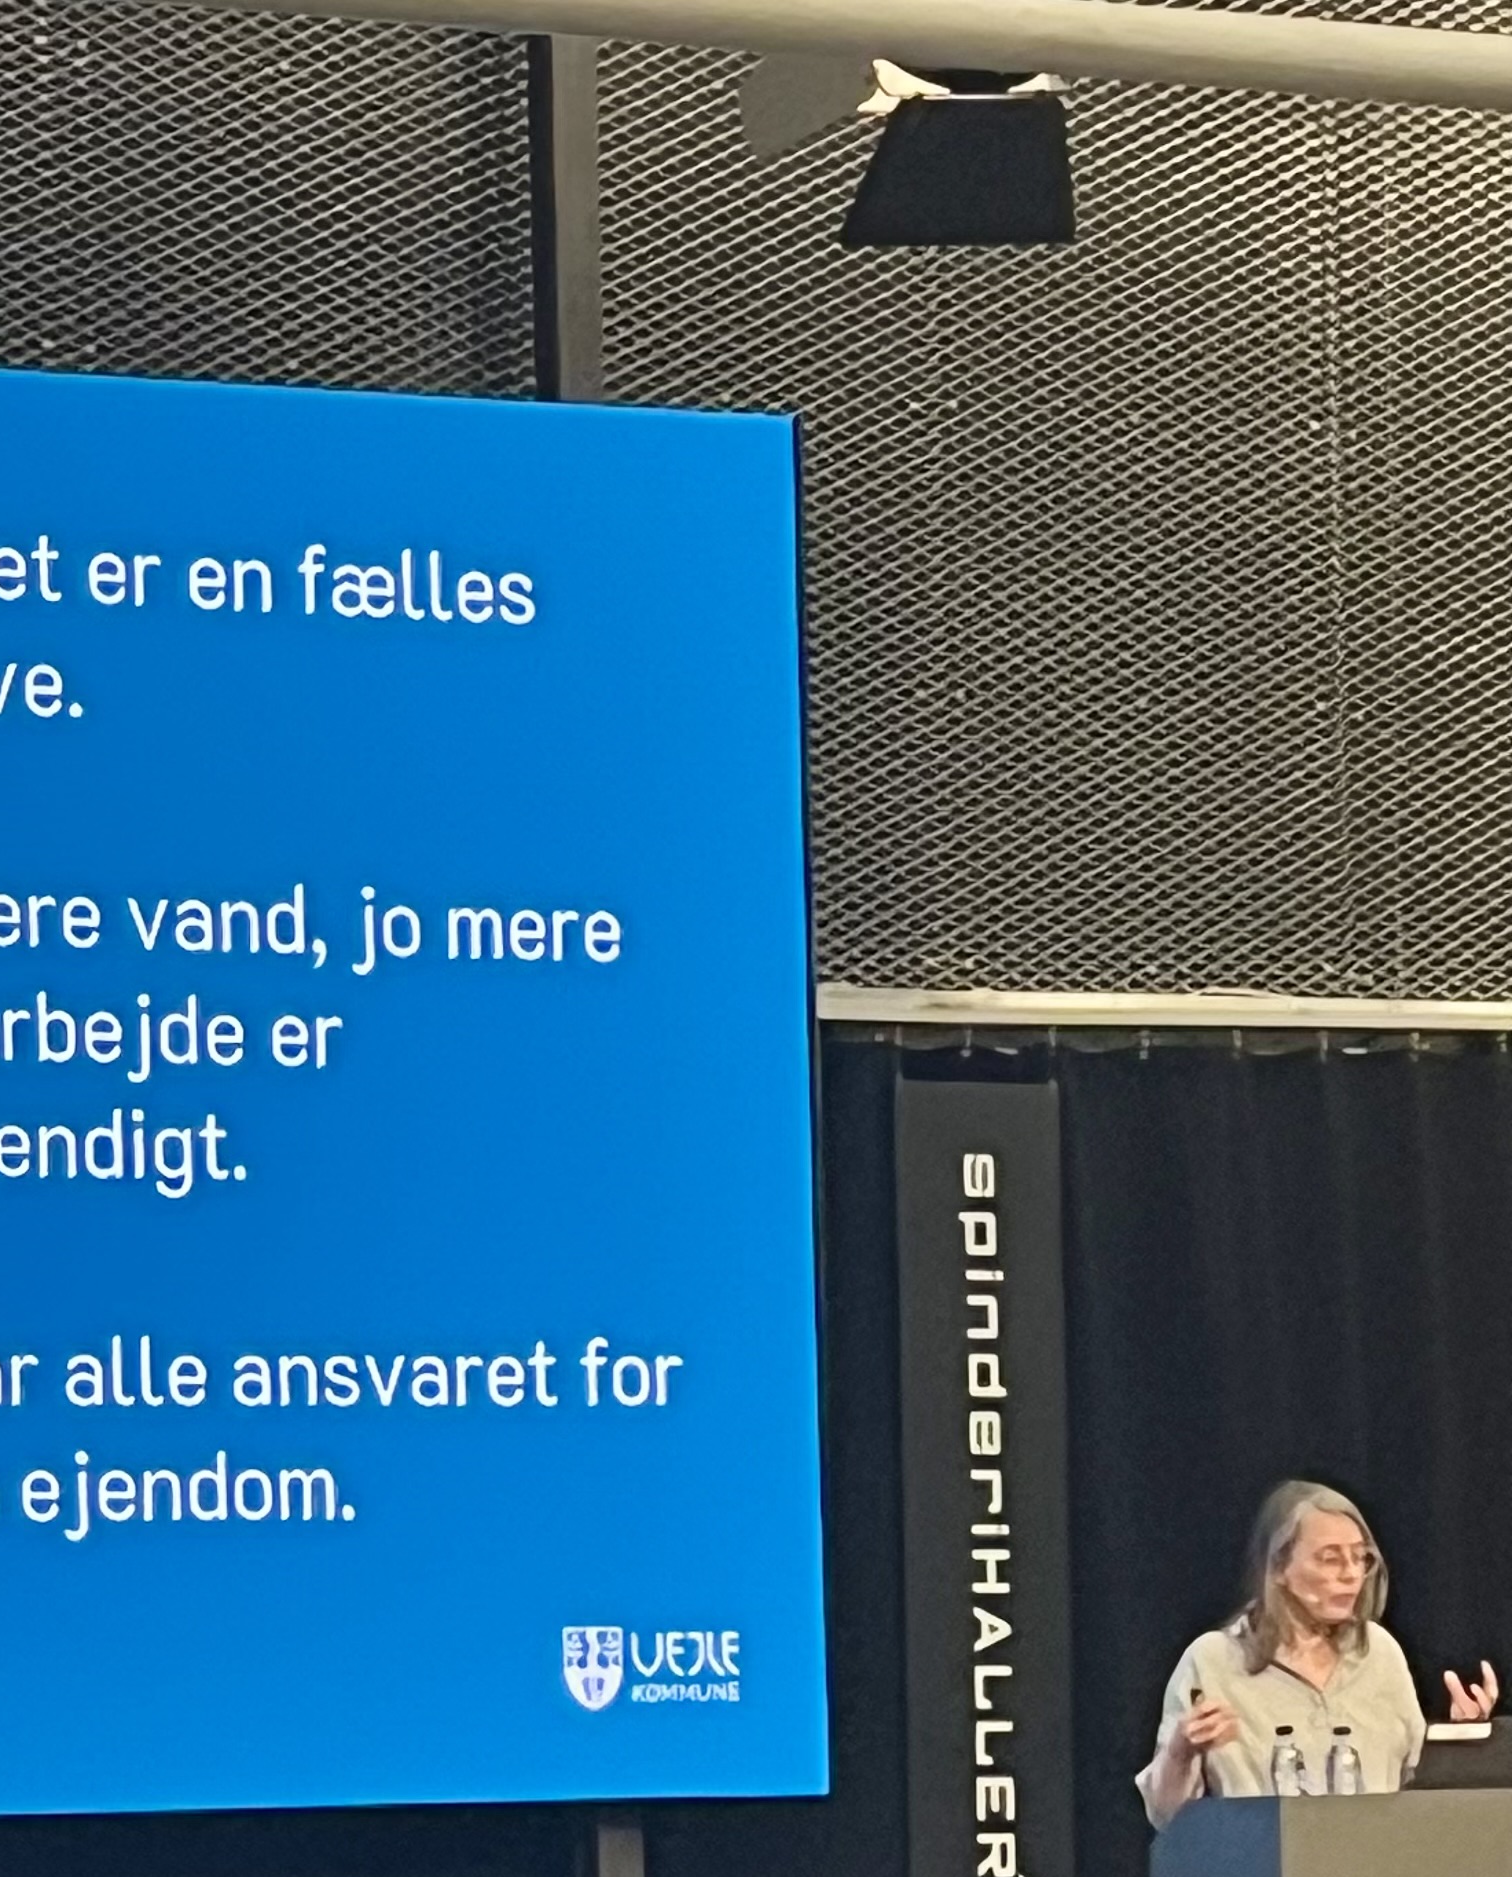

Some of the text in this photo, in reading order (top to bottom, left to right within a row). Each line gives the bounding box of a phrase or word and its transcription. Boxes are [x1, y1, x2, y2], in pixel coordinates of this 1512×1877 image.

[88, 552, 162, 607] er
[188, 557, 273, 613] en
[297, 543, 536, 625] fælles
[127, 883, 327, 969] vand,
[351, 885, 421, 976] jo
[447, 907, 621, 963] mere
[271, 1014, 343, 1069] er
[65, 1334, 207, 1407] alle
[233, 1340, 559, 1408] ansvaret
[579, 1336, 684, 1407] for
[21, 1450, 356, 1542] ejendom.
[630, 1630, 740, 1678] VEJLE
[631, 1681, 740, 1703] KOMMUNE
